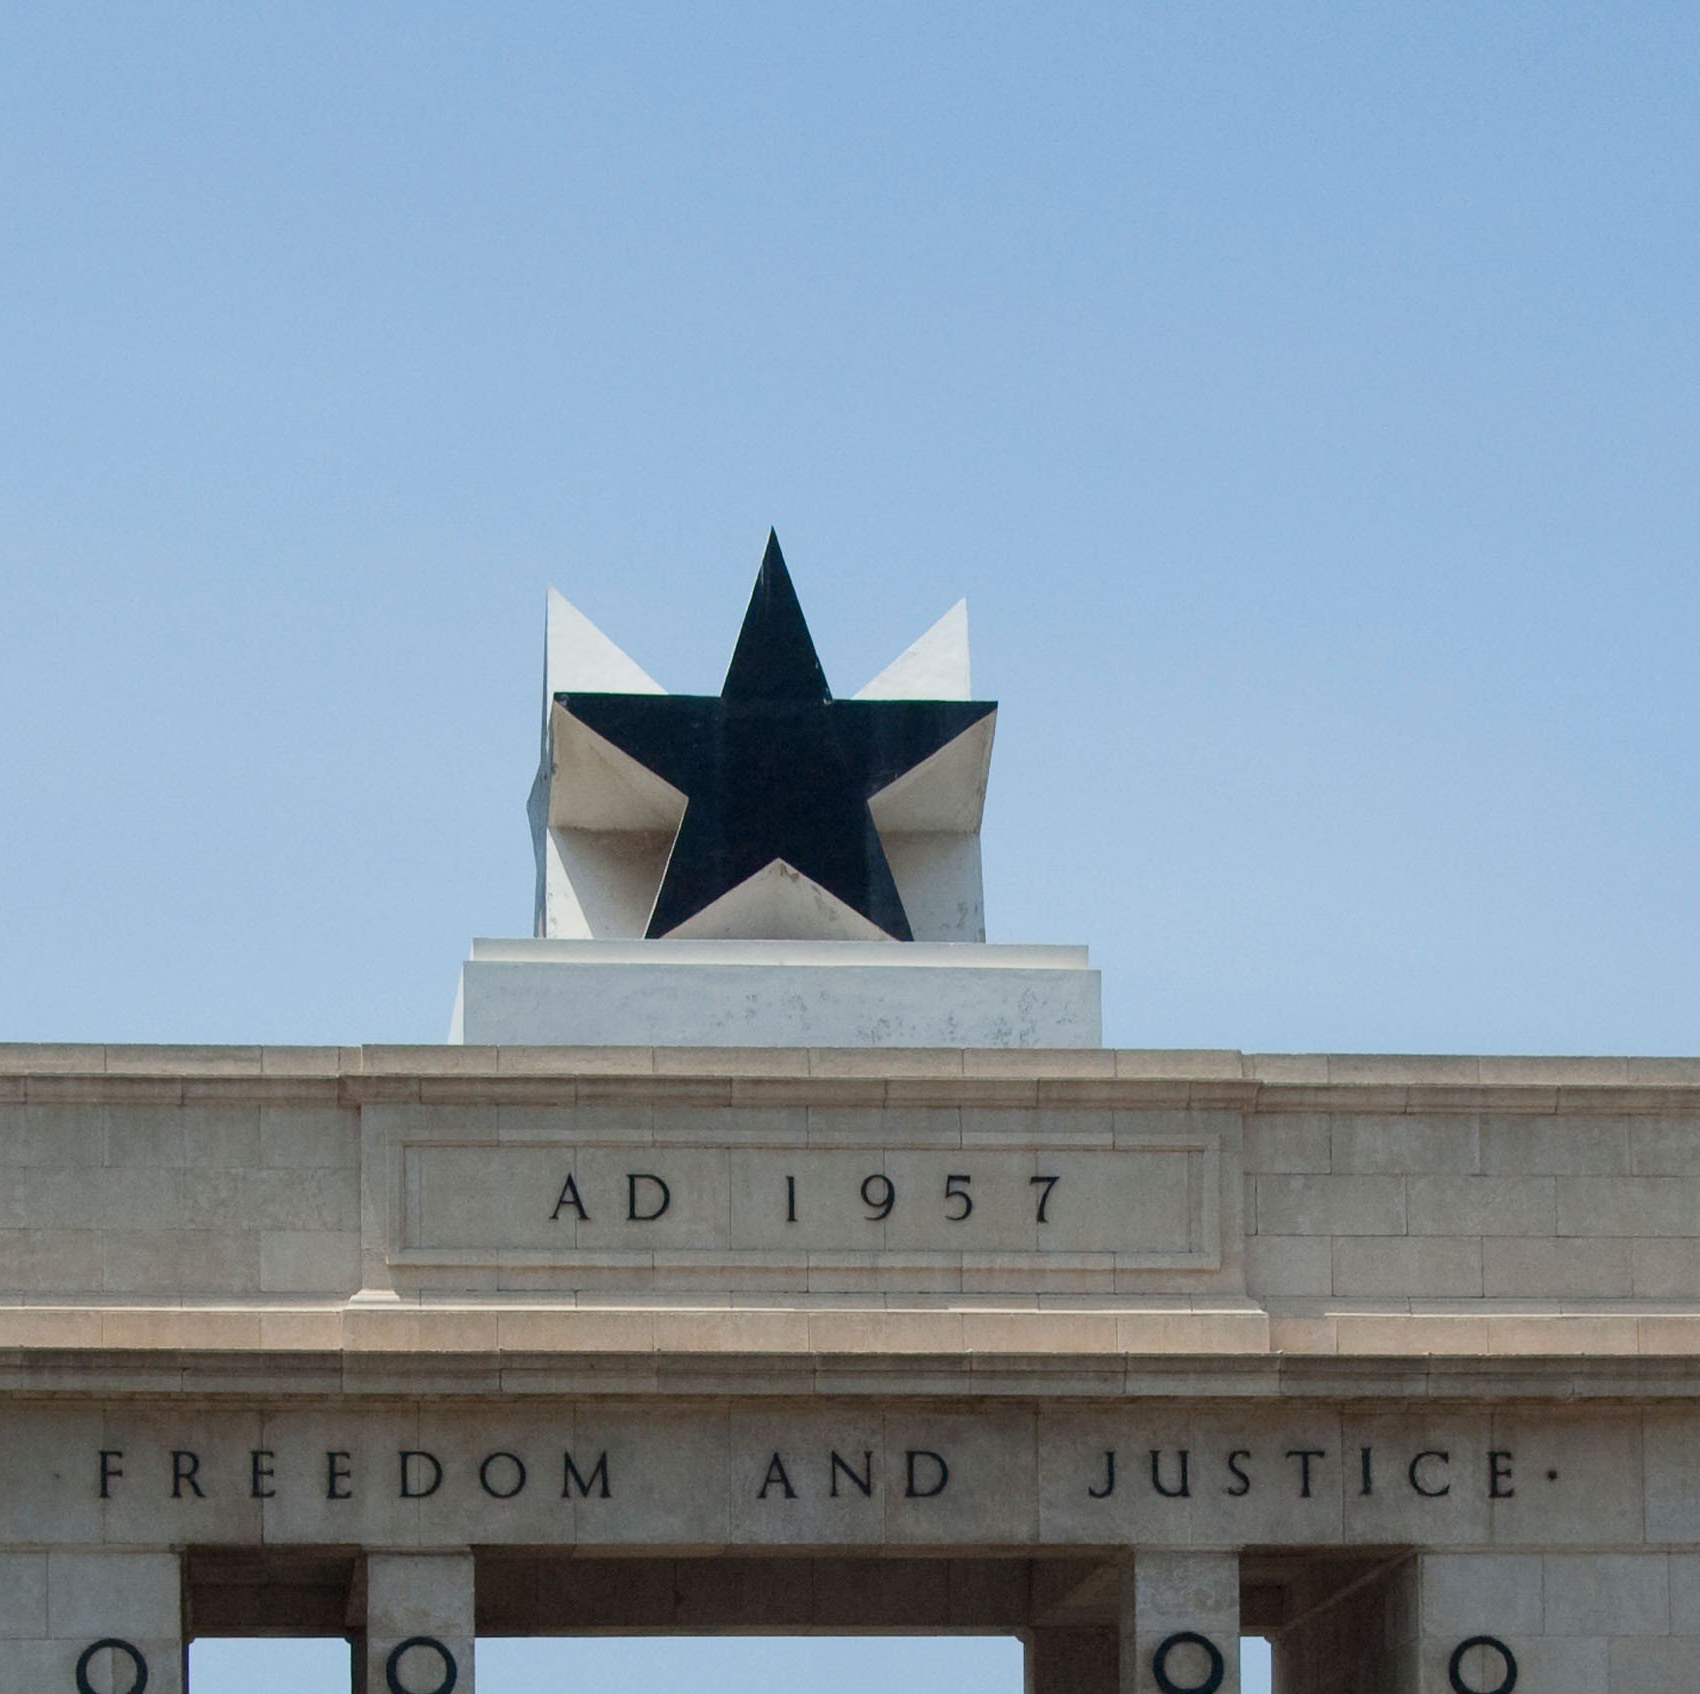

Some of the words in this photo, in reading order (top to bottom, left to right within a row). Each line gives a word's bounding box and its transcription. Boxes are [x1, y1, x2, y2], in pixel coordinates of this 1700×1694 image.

[549, 1172, 671, 1222] AD
[786, 1174, 1061, 1223] 1957
[98, 1450, 613, 1500] FREEDOM
[756, 1449, 951, 1500] AND
